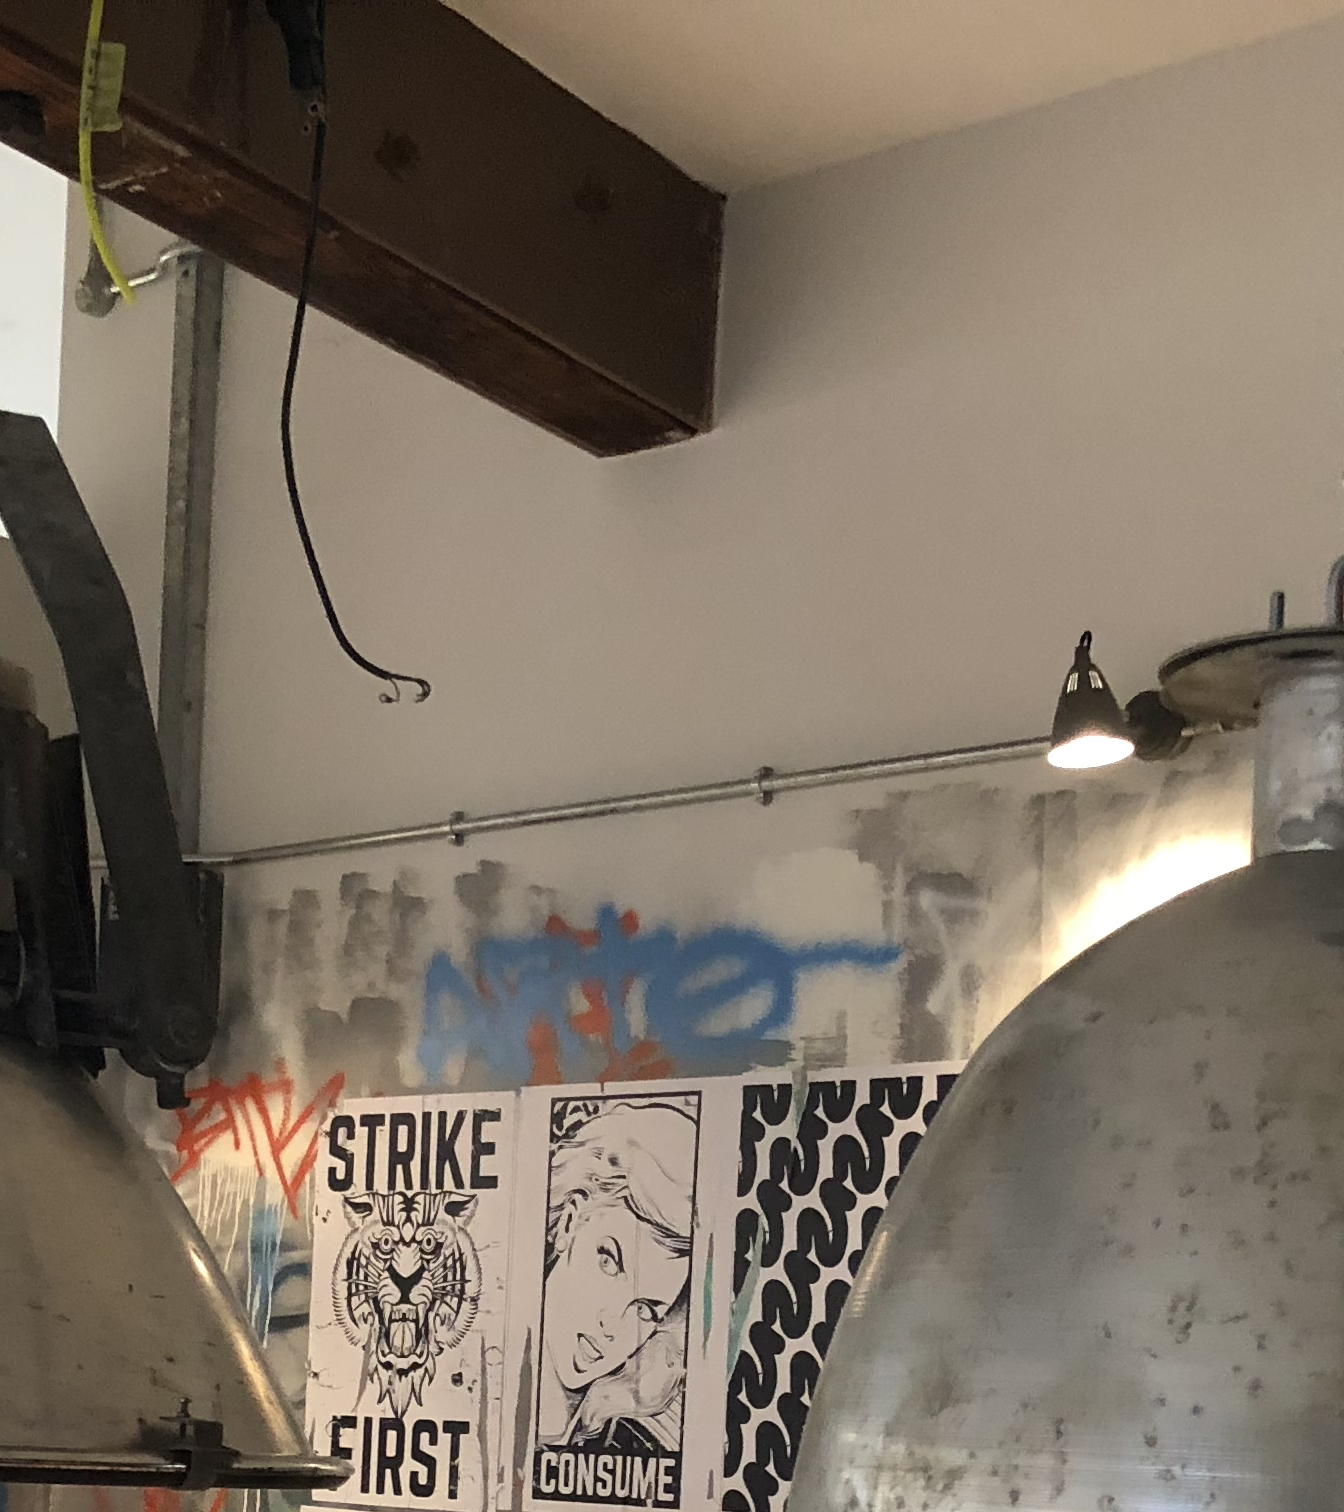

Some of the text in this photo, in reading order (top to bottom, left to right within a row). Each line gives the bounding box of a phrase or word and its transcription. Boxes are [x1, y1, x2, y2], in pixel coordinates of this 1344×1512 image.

[327, 1107, 502, 1192] STRIKE
[330, 1415, 470, 1500] FIRST
[539, 1451, 677, 1502] CONSUME
